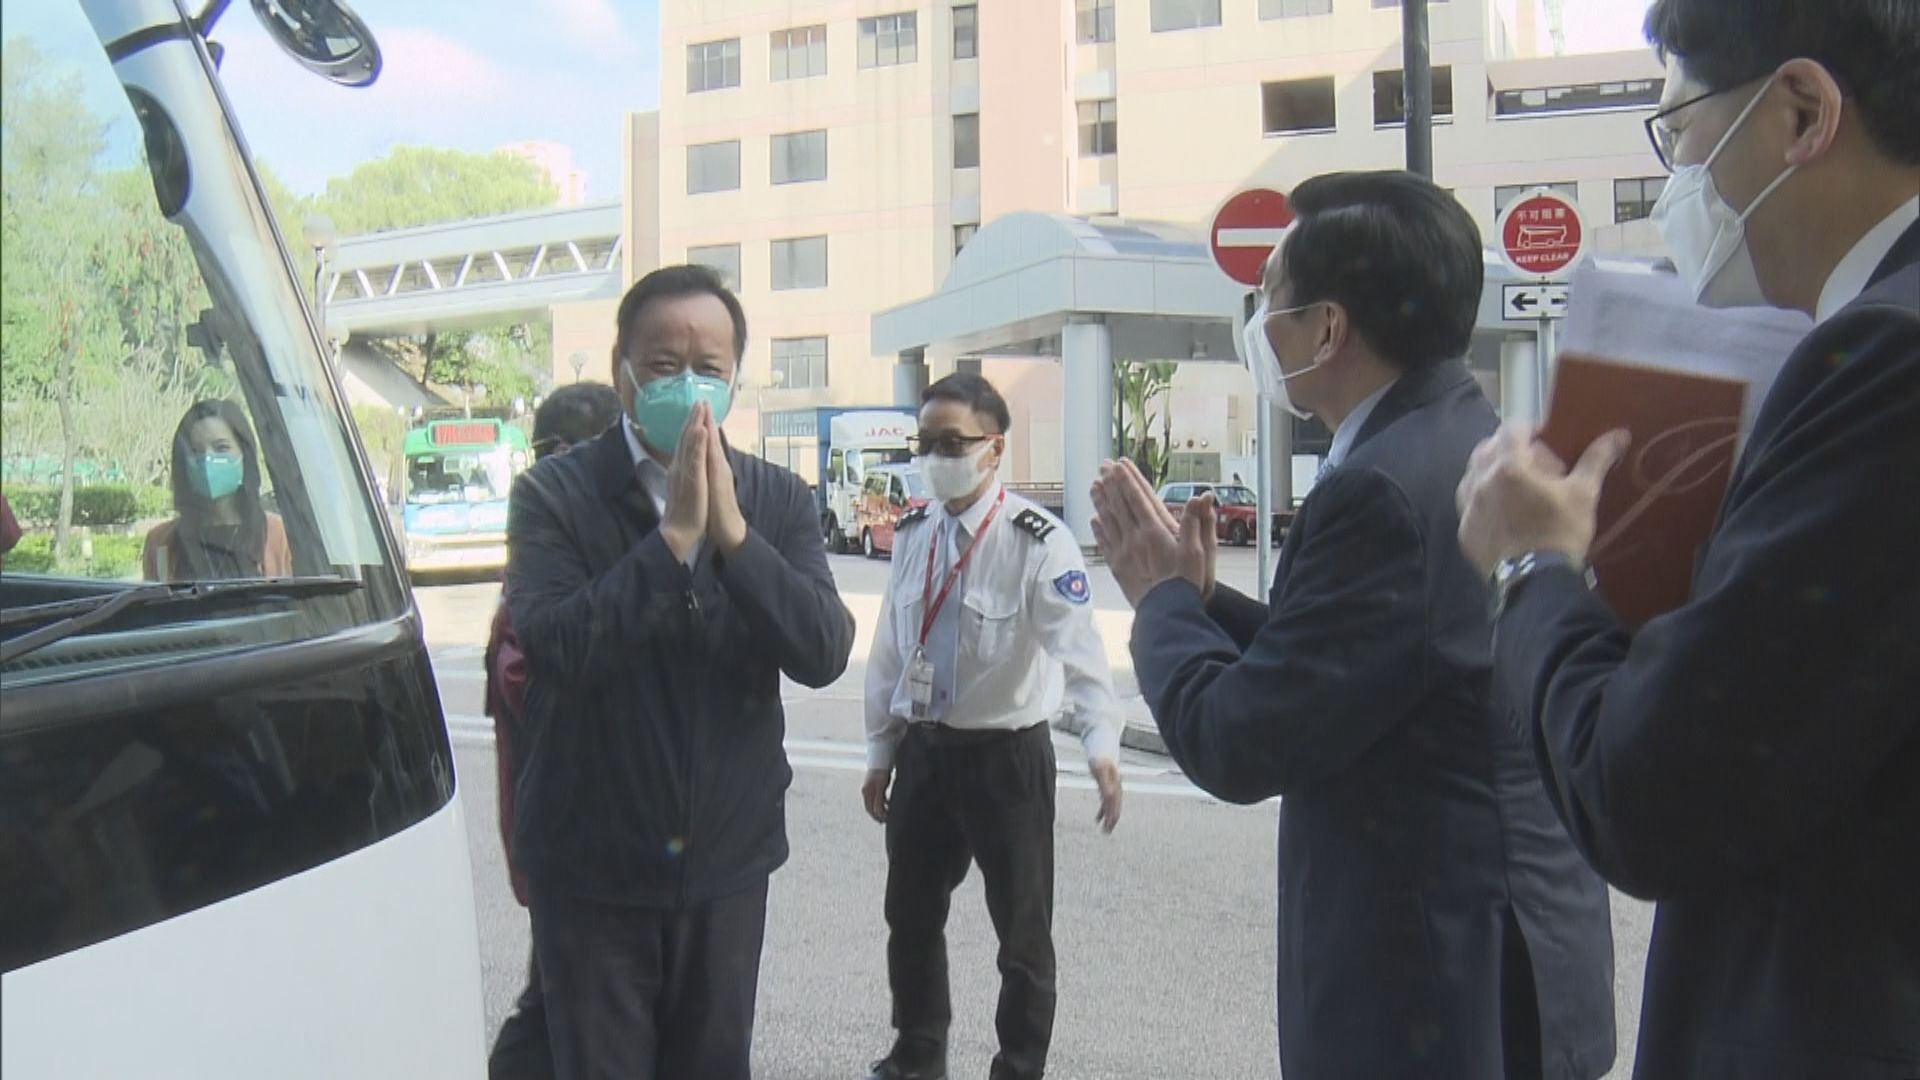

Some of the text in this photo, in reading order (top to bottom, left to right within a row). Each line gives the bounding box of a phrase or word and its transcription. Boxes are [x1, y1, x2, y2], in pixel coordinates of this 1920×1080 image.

[1515, 252, 1569, 263] KEEP CLEAR
[864, 426, 905, 438] JAC
